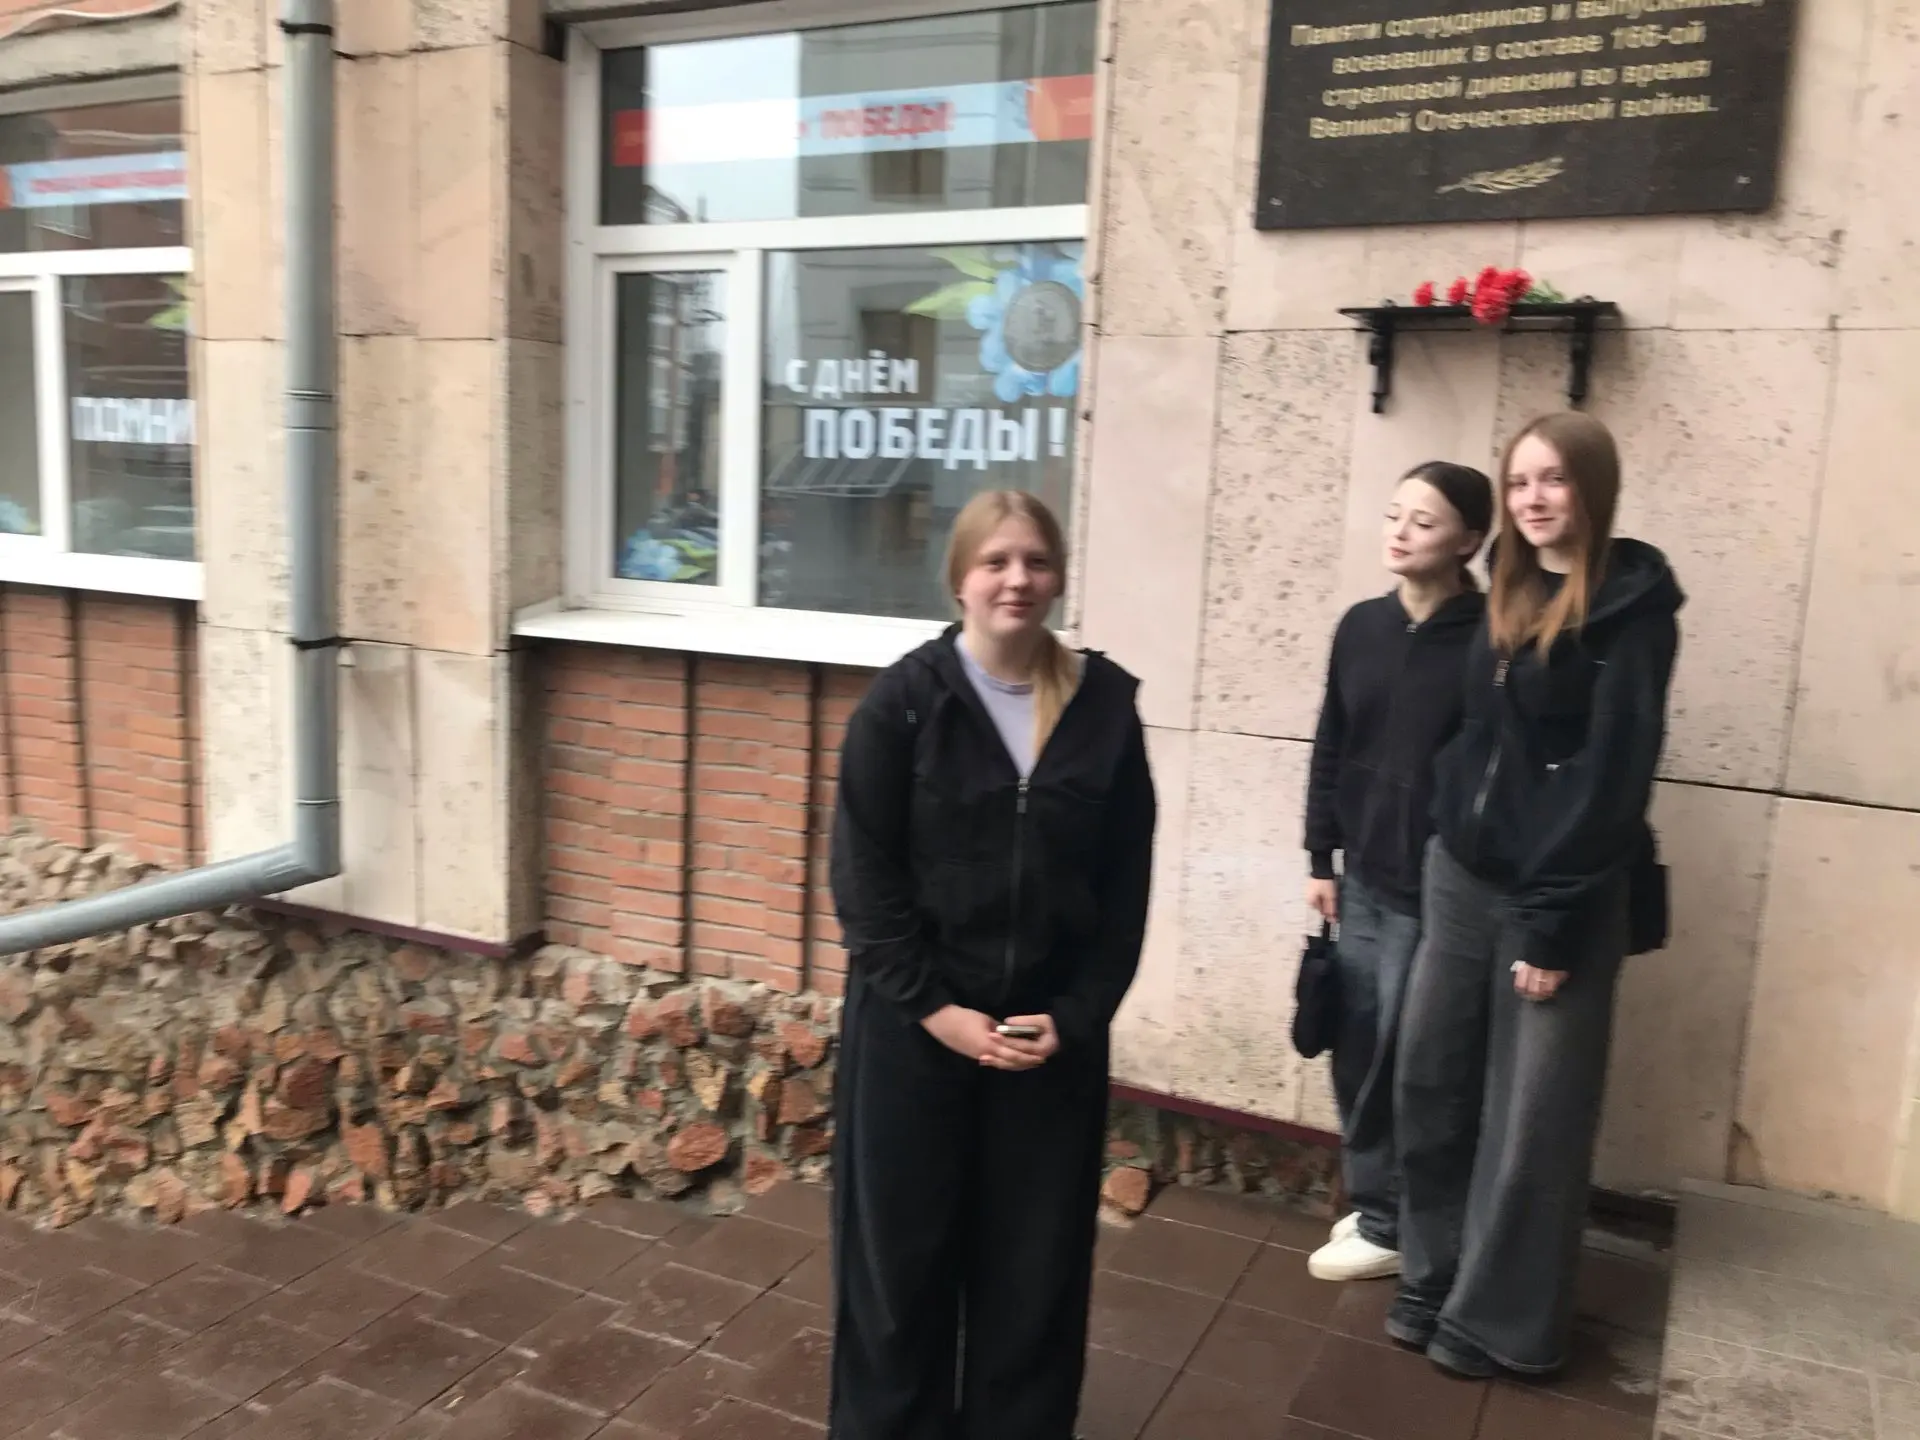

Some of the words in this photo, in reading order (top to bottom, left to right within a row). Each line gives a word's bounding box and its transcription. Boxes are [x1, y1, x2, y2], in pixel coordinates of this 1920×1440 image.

[1290, 23, 1382, 46] Памяти
[1385, 7, 1547, 39] сотрудников
[1551, 3, 1571, 21] и
[1332, 47, 1471, 75] воевавших
[1472, 45, 1491, 62] в
[1495, 34, 1604, 60] составе
[1322, 76, 1463, 110] стрелковой
[1465, 71, 1577, 99] дивизии
[1580, 67, 1618, 86] во
[1621, 60, 1712, 87] время
[1310, 111, 1412, 139] Великой
[1415, 96, 1616, 132] Отечественной
[784, 358, 809, 393] С
[811, 350, 919, 399] ДНЁМ
